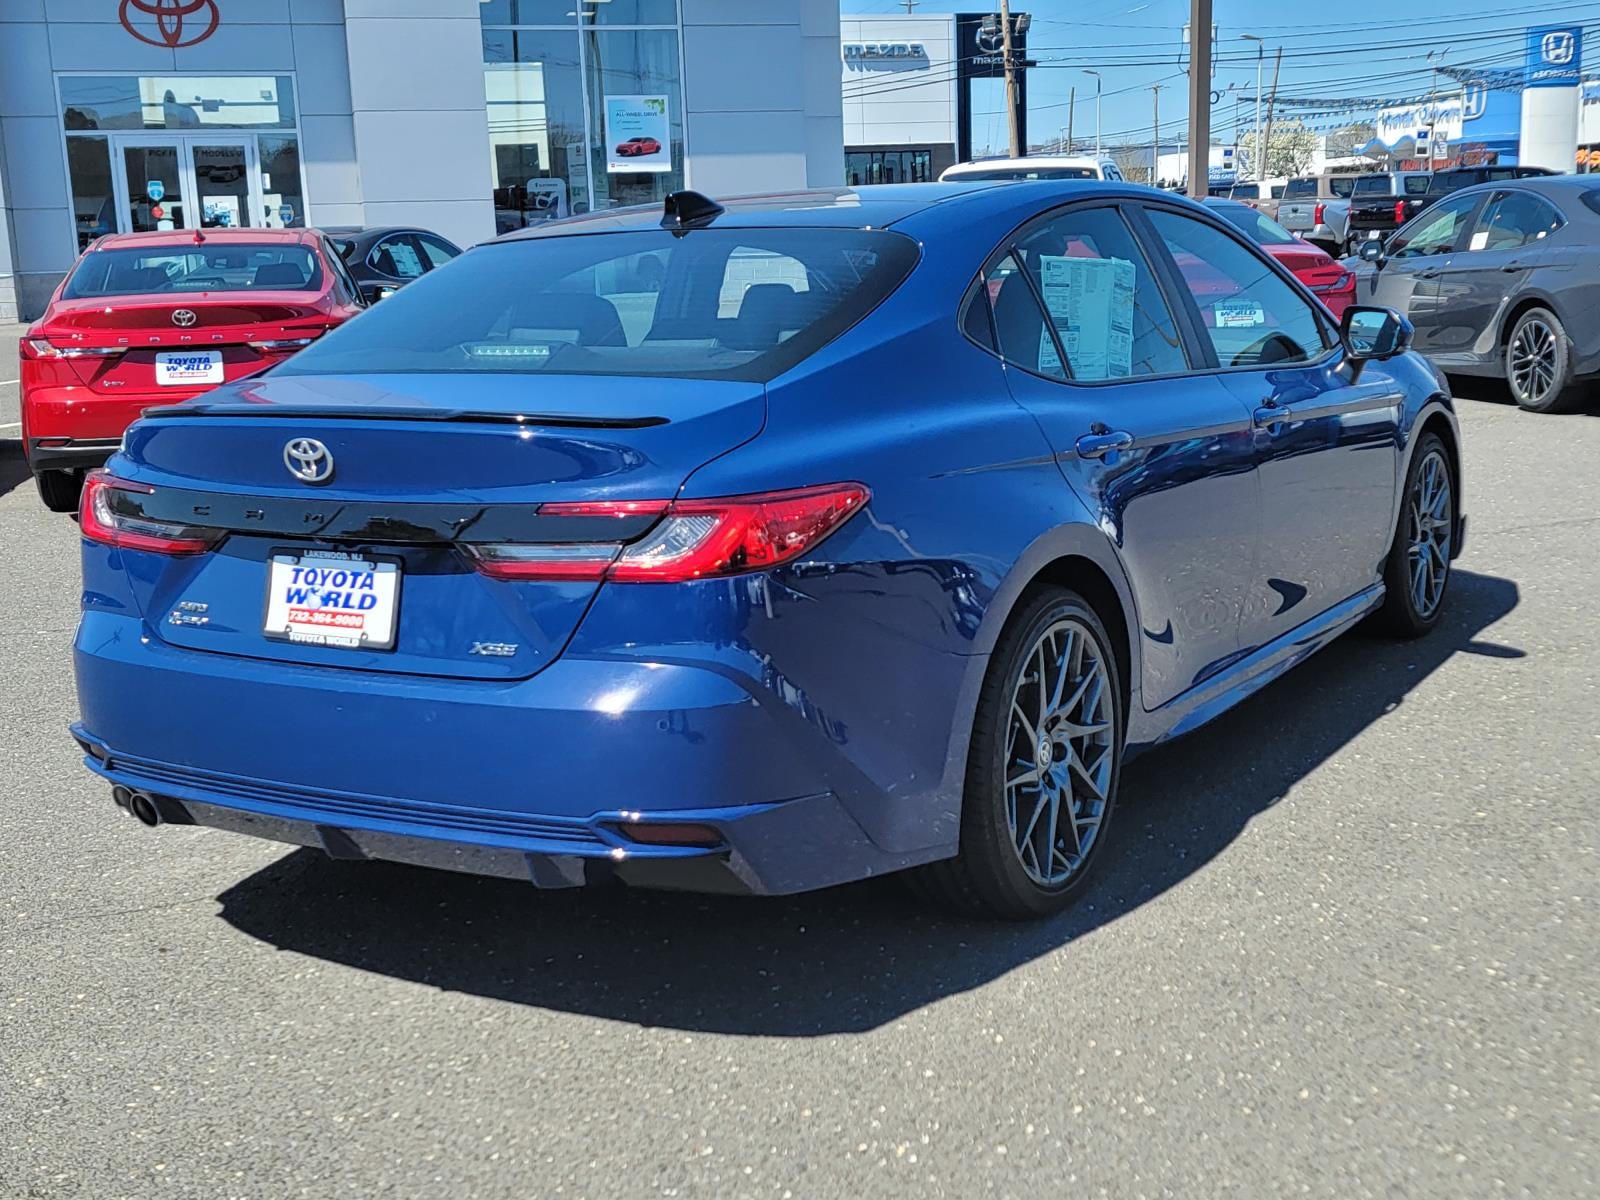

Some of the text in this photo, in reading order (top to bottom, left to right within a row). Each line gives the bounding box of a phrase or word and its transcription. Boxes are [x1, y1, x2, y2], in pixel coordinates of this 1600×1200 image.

[972, 55, 1007, 65] mazd
[118, 332, 256, 344] CAMRY
[168, 356, 210, 365] TOYOTA
[166, 364, 212, 372] WRLD
[193, 504, 469, 531] CAMRY
[291, 567, 375, 590] TOYOTA
[289, 632, 360, 648] TOYOTA WORLD
[468, 641, 518, 657] XSE
